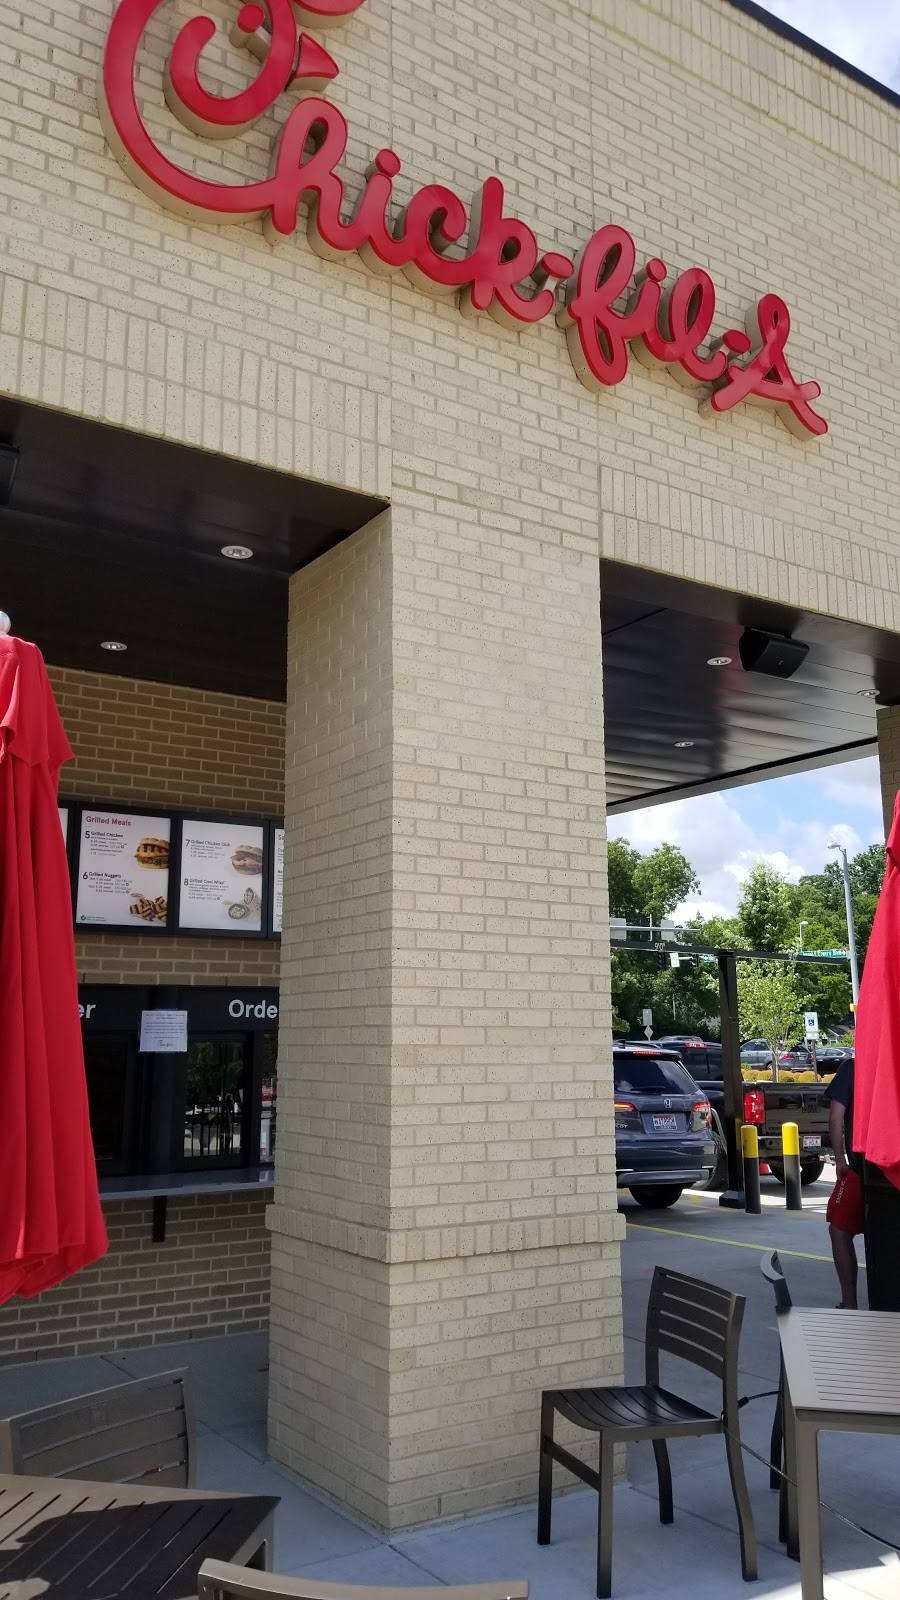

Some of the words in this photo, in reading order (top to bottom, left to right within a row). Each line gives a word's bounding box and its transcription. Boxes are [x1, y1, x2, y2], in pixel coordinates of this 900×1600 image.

[86, 816, 110, 825] Grilled
[111, 818, 132, 826] Meals
[84, 830, 90, 839] 5
[185, 839, 190, 847] 7
[82, 871, 88, 880] 6
[184, 878, 189, 886] 8
[78, 1003, 96, 1019] er
[228, 999, 278, 1019] Orde
